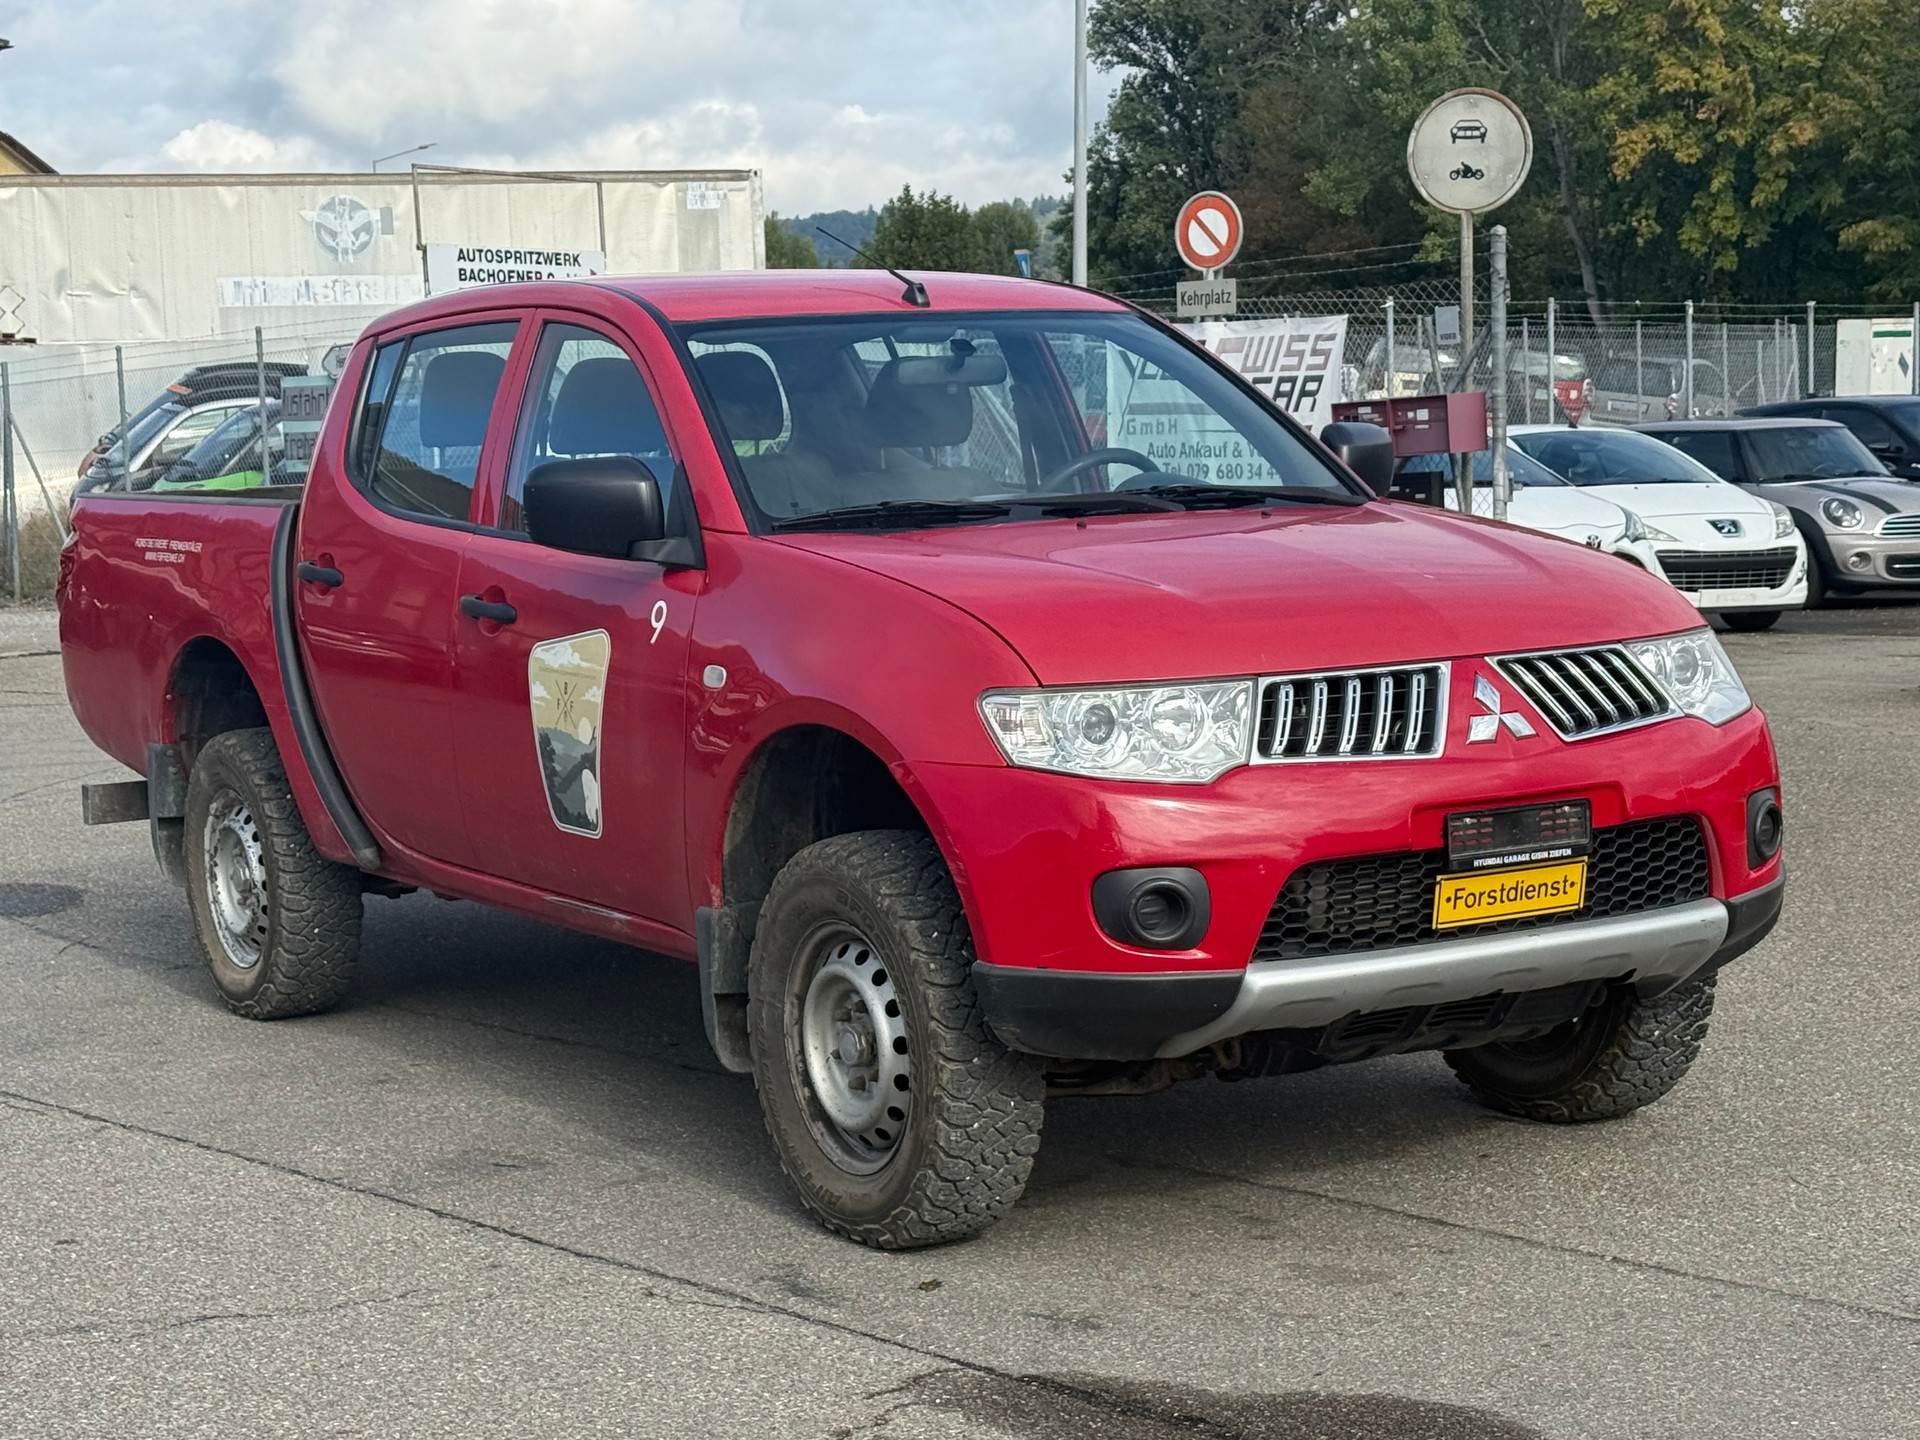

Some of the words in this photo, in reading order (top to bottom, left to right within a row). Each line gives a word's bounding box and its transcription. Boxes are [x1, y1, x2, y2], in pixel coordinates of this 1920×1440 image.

[457, 248, 582, 267] AUTOSPRITZWERK
[1180, 288, 1232, 309] Kehrplatz
[1147, 442, 1176, 458] Auto
[1179, 441, 1228, 458] Ankauf
[1232, 441, 1242, 458] &
[1187, 463, 1210, 480] 079
[1216, 463, 1243, 480] 680
[1247, 463, 1262, 480] 34
[649, 600, 668, 644] 9
[1473, 856, 1503, 868] HYUNDAI
[1503, 853, 1530, 864] GARAGE
